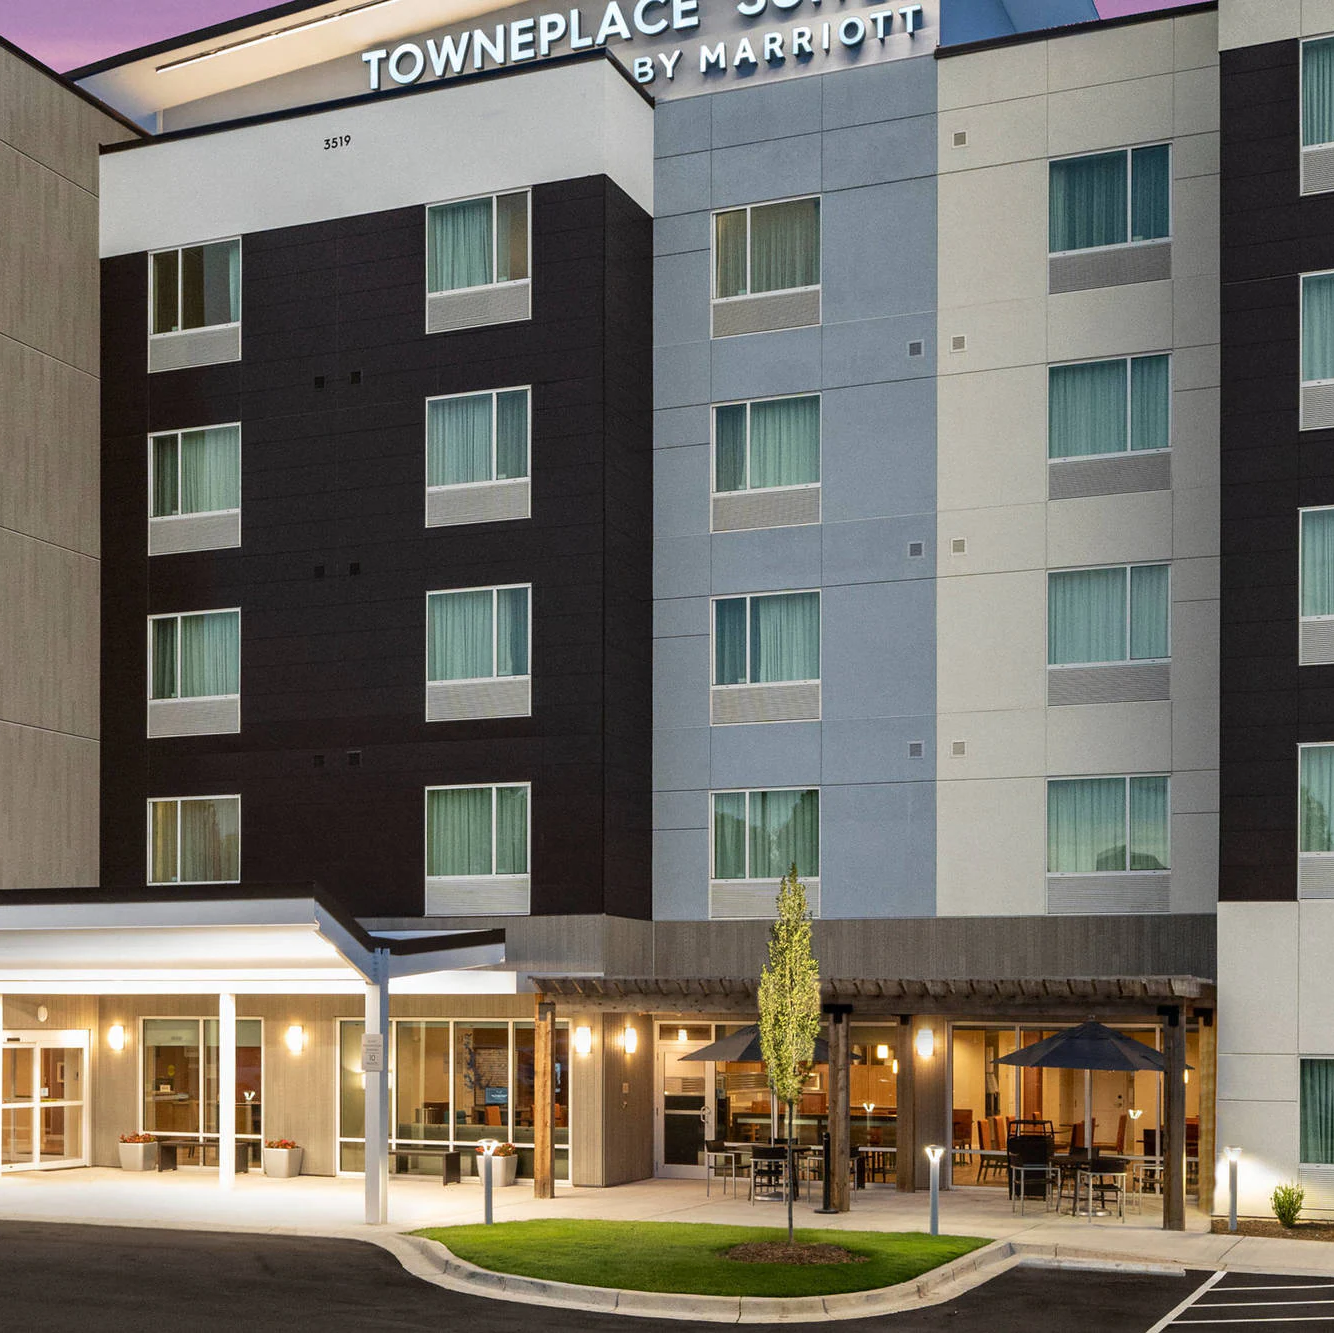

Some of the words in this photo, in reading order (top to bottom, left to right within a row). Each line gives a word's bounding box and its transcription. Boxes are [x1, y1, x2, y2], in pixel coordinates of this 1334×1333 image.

[362, 0, 699, 90] TOWNEPLACE
[633, 50, 682, 83] BY
[699, 4, 922, 73] MARRIOTT
[323, 134, 352, 151] 3519
